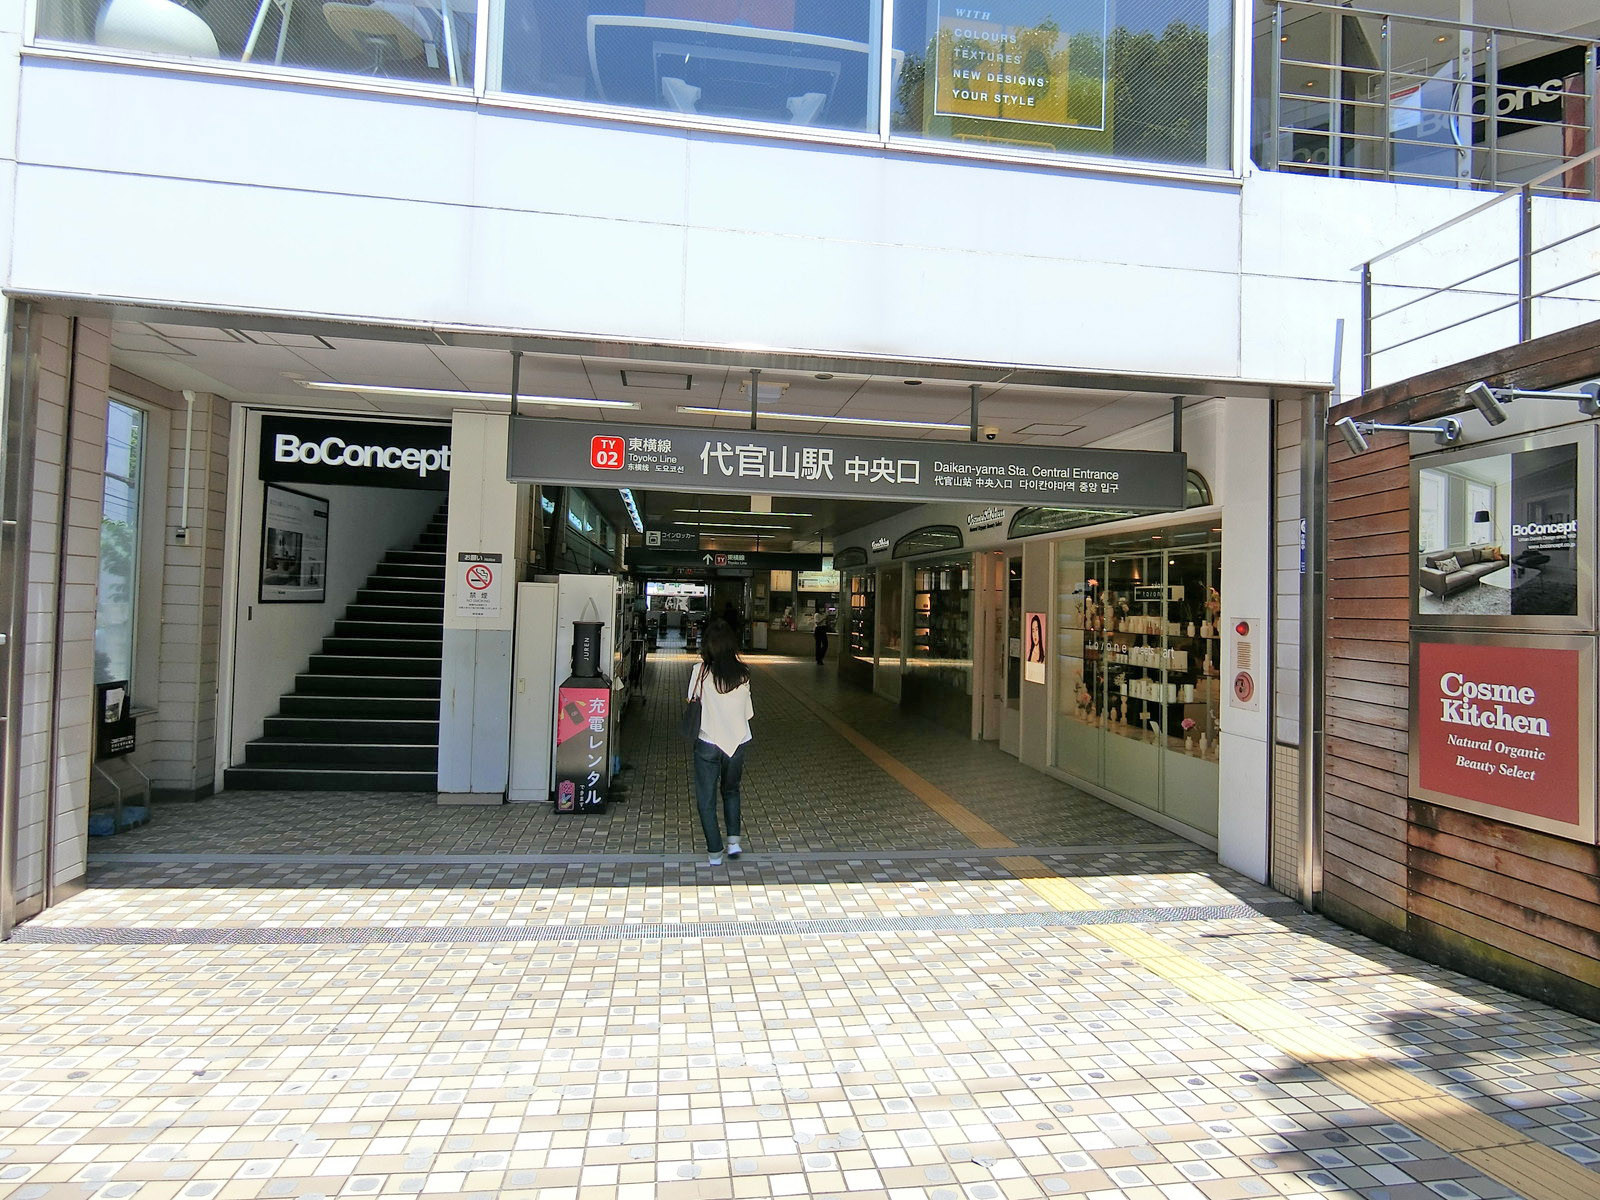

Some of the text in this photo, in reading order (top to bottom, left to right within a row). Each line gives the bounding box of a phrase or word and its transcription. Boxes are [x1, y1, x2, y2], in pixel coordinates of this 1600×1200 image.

[955, 8, 991, 21] WITH
[954, 28, 1017, 44] COLOURS
[953, 48, 1021, 65] TEXTURES
[953, 69, 1045, 88] NEW DESIGNS
[952, 89, 1035, 107] YOUR STYLE
[600, 439, 616, 450] TY
[628, 437, 672, 454] 東横線
[274, 433, 451, 478] BoConcept
[596, 450, 618, 466] 02
[659, 455, 677, 464] Line
[699, 441, 920, 485] 代官山駅 中央口
[655, 465, 684, 474] 도요코선
[934, 461, 1119, 480] Daikan-yama Sta. Central Entrance
[934, 476, 1013, 489] 代官山站 中央入口
[1019, 480, 1119, 494] 다이칸야마역 중앙 입구
[662, 532, 695, 540] コインロッカー
[1512, 520, 1577, 536] BoConcept
[1162, 647, 1175, 659] art
[1440, 672, 1535, 705] Cosme
[1440, 697, 1550, 737] Kitchen
[585, 697, 605, 804] 充電レンタル
[1447, 733, 1546, 761] Natural Organic
[1456, 755, 1536, 781] Beauty Select
